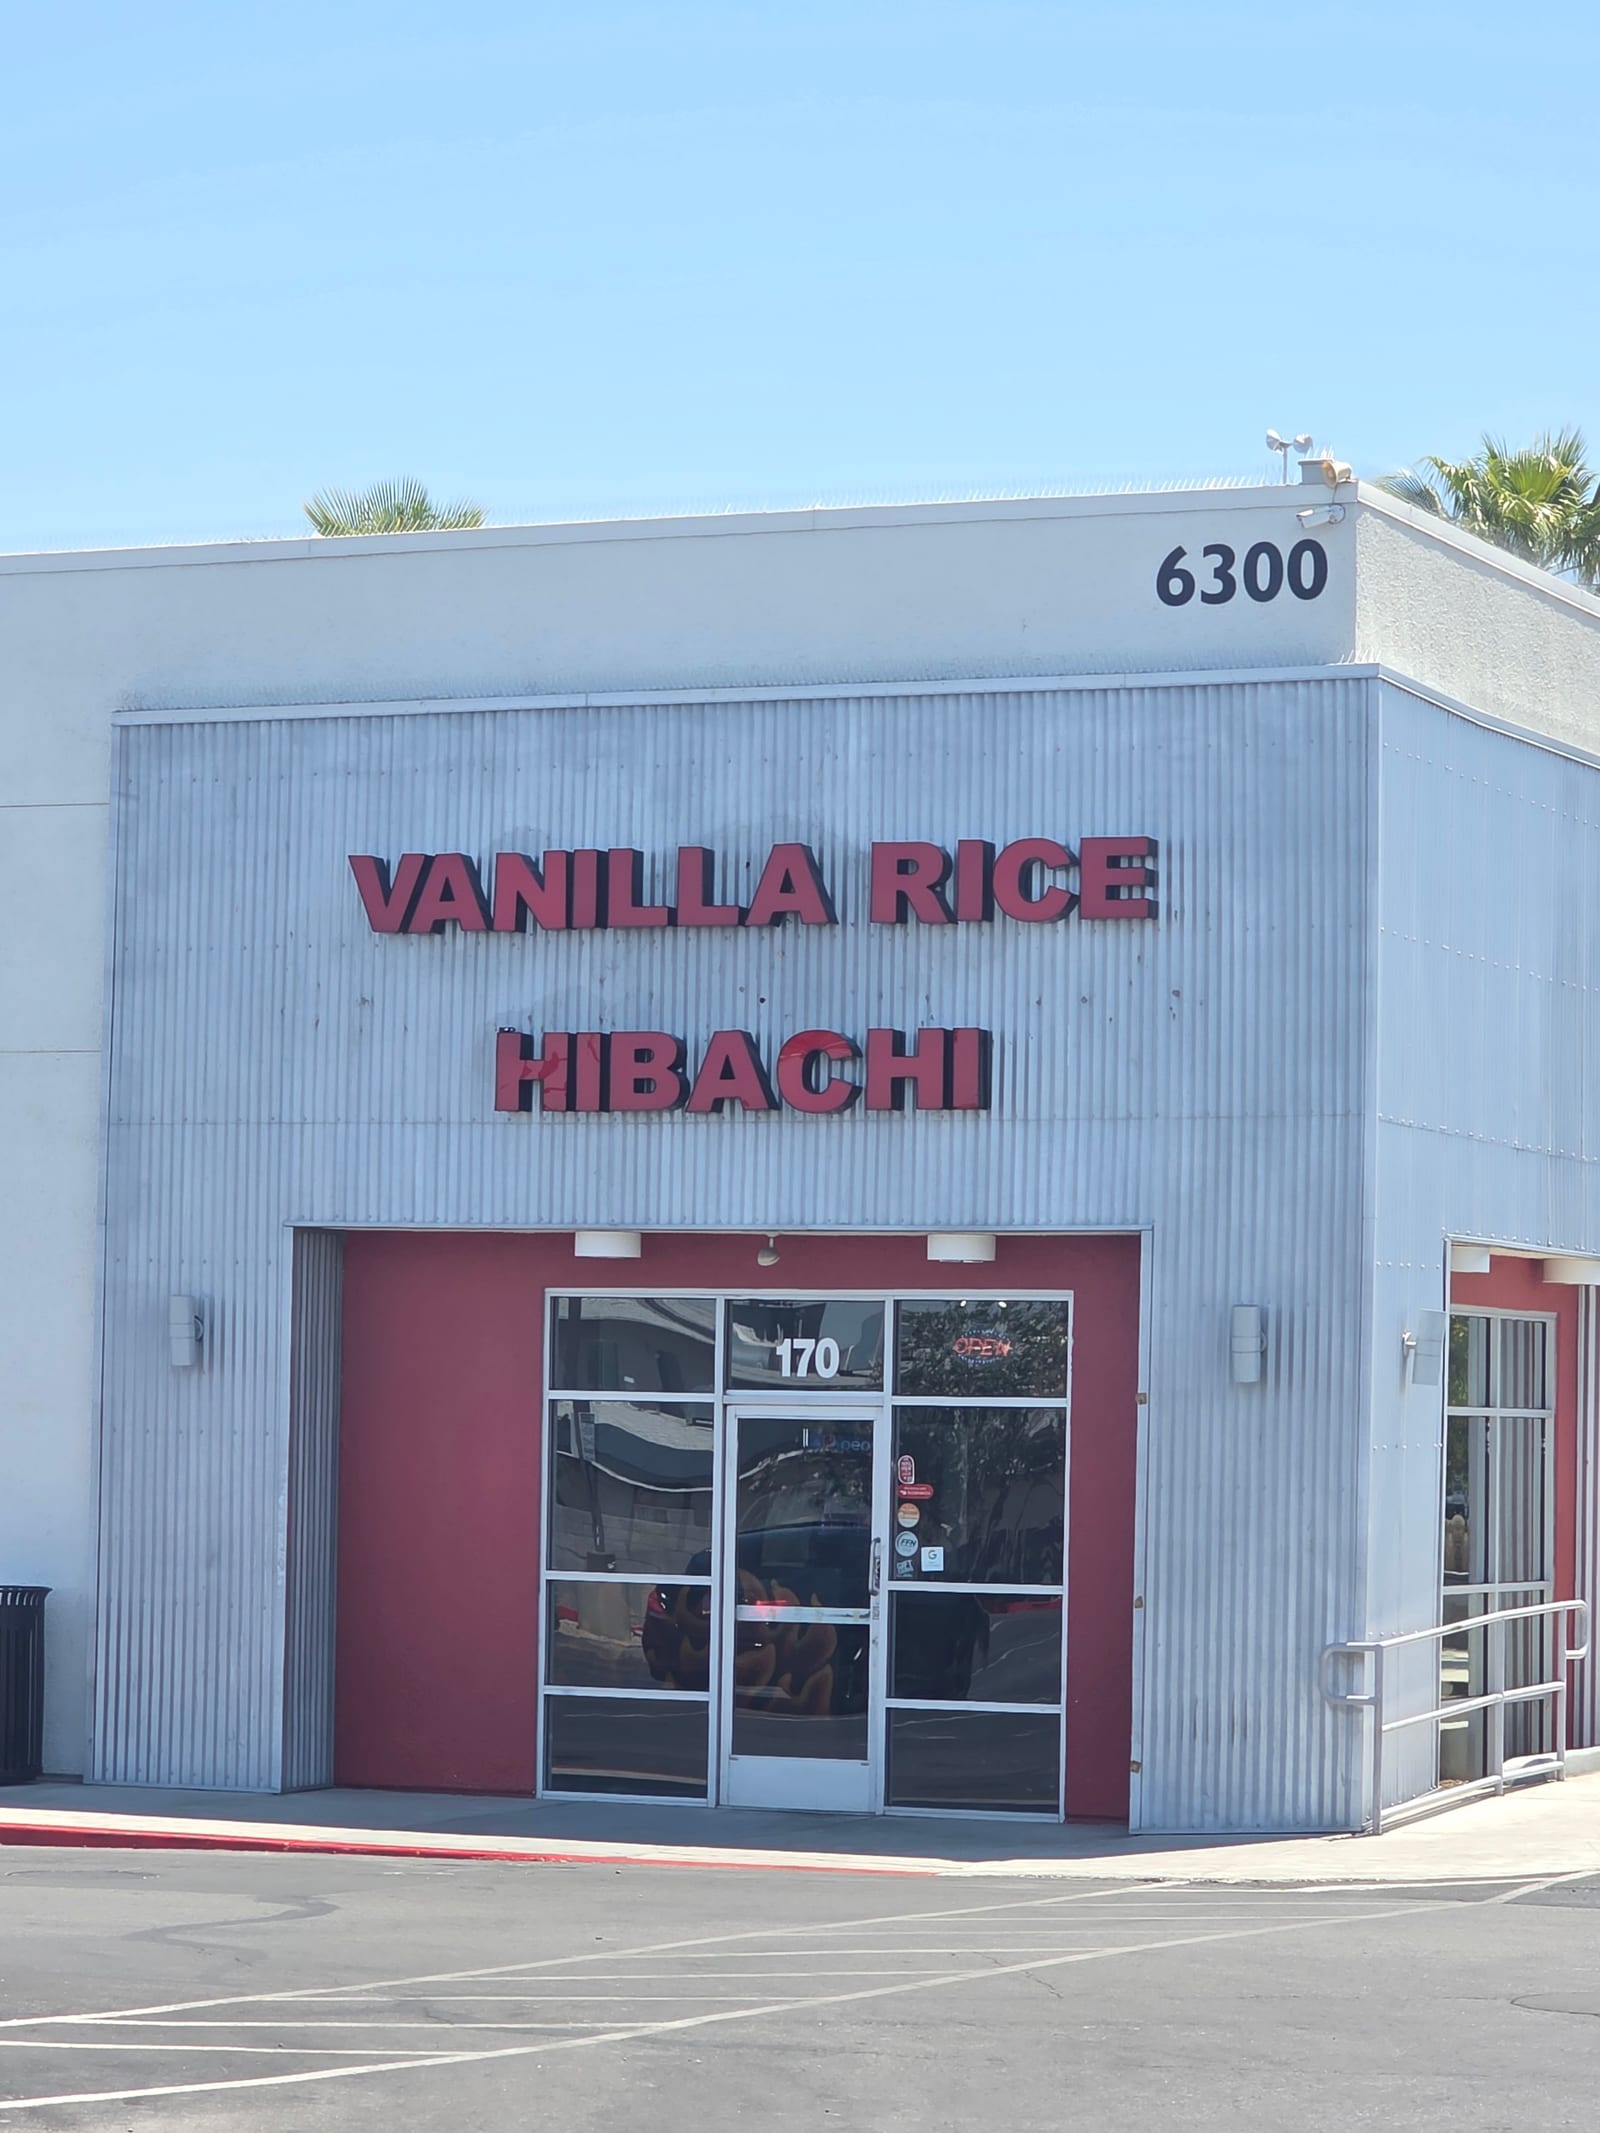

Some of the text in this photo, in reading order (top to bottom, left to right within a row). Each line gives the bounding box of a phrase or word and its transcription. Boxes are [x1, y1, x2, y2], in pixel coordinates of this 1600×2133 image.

[1156, 538, 1328, 606] 6300
[348, 836, 1158, 934] VANILLA RICE
[494, 1027, 990, 1113] HIBACHI
[776, 1337, 840, 1379] 170
[952, 1337, 1011, 1356] OPEN
